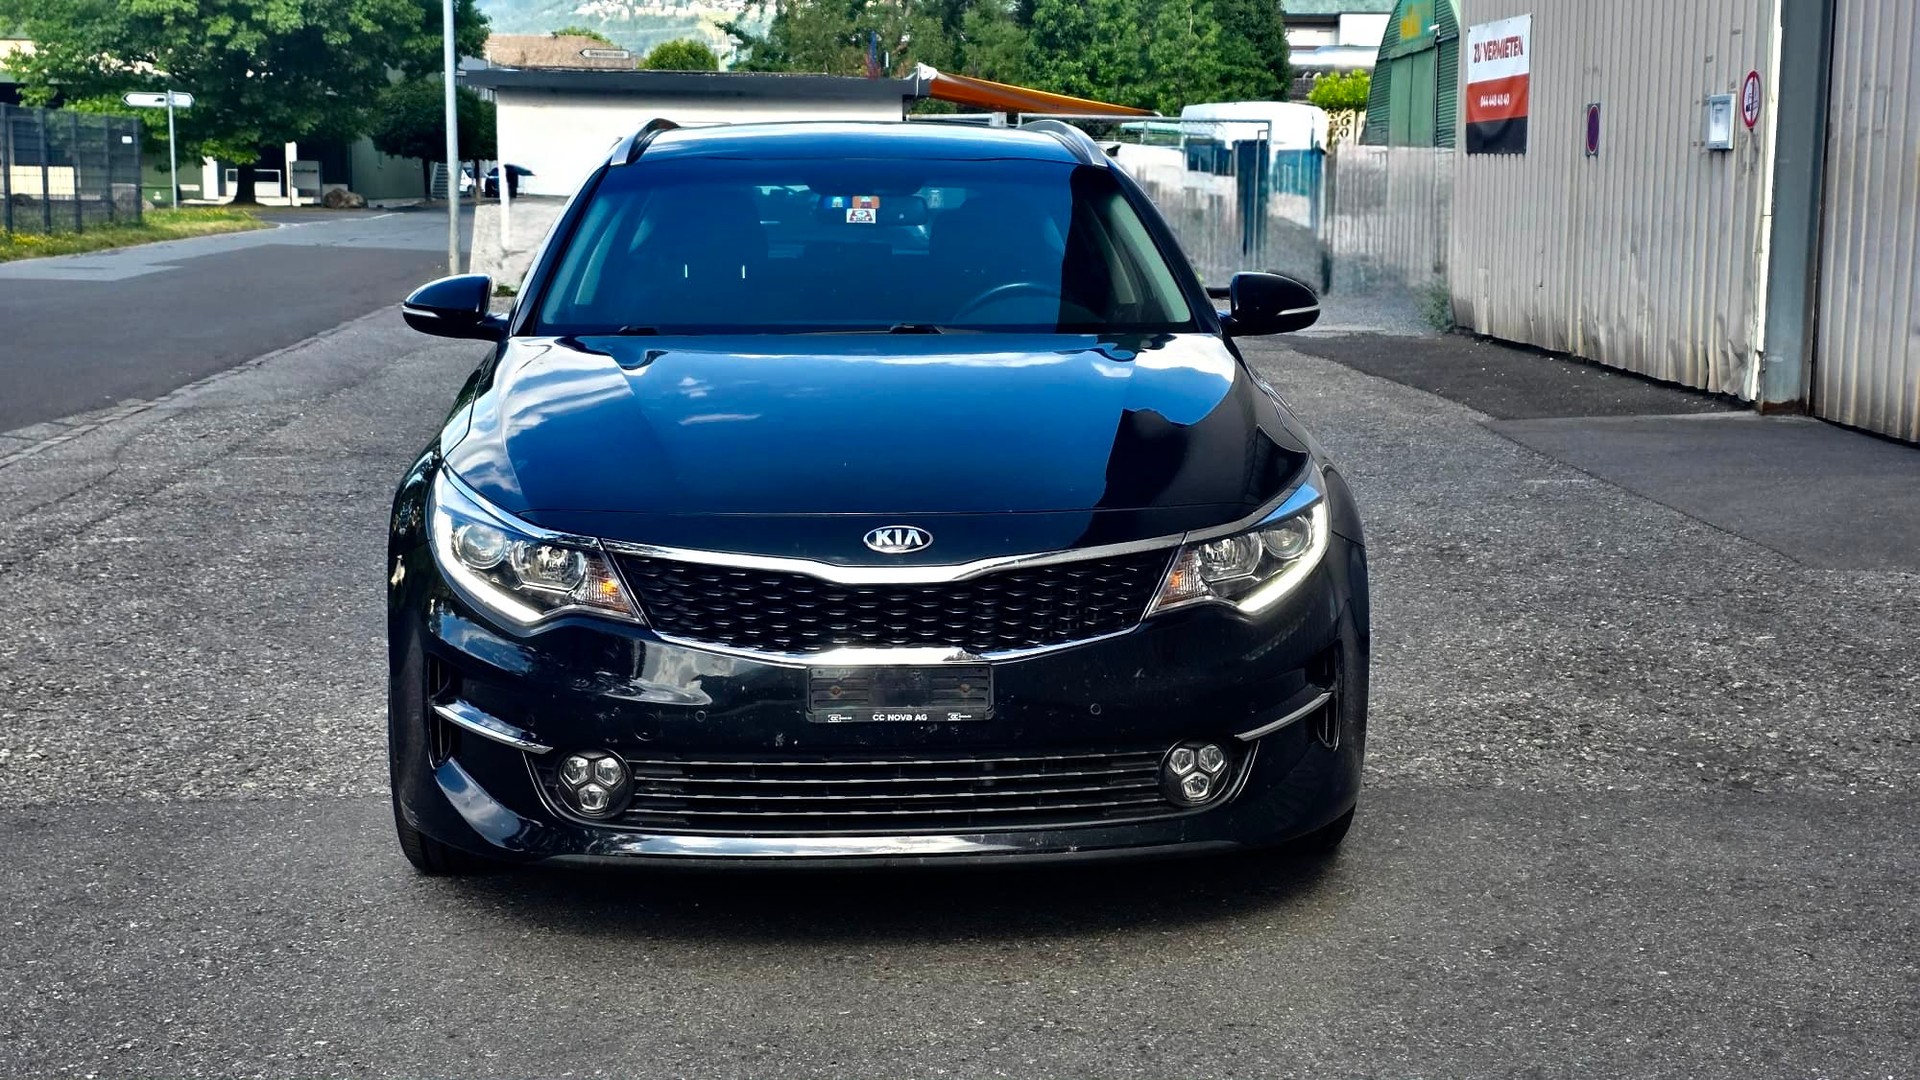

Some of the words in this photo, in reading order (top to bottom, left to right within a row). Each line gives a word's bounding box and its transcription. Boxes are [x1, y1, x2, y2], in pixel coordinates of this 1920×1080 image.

[1473, 42, 1482, 63] ZU
[1483, 36, 1523, 62] VERMIETEN
[1481, 95, 1489, 108] 044
[875, 529, 923, 546] KIA
[914, 713, 928, 721] AG
